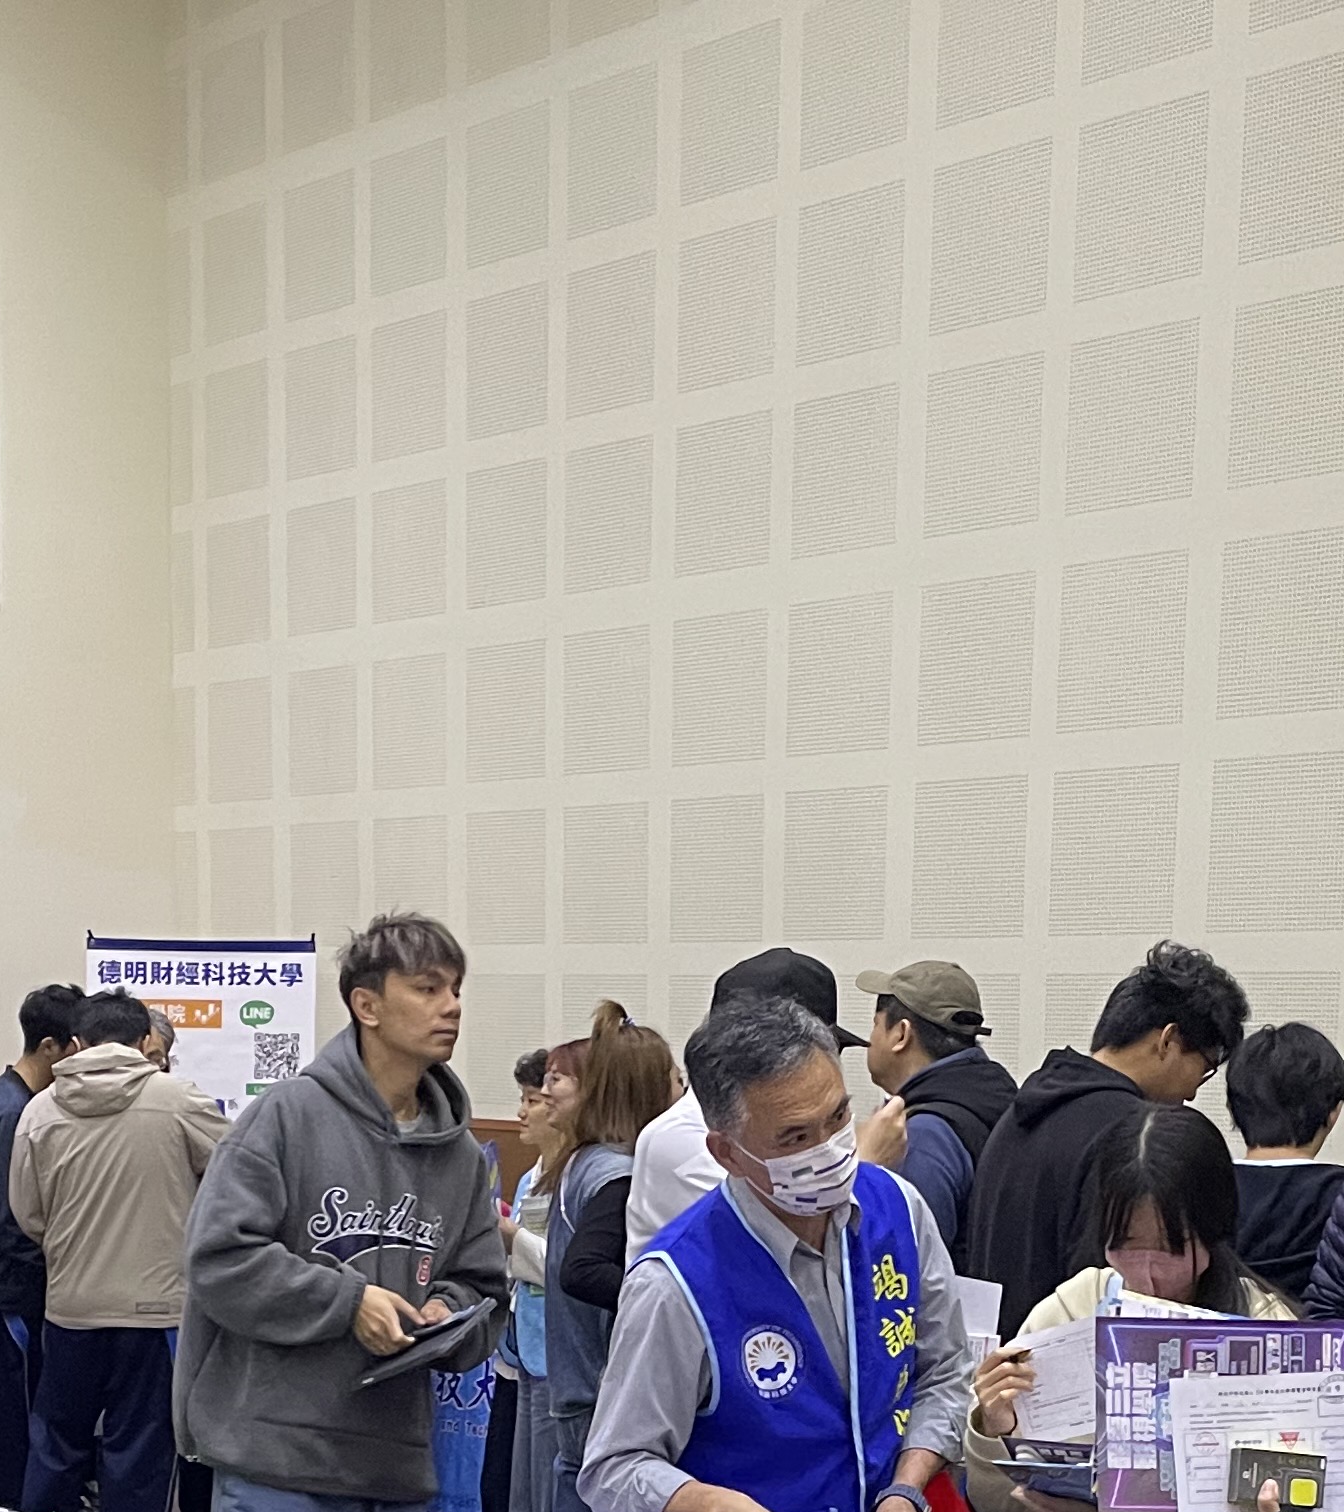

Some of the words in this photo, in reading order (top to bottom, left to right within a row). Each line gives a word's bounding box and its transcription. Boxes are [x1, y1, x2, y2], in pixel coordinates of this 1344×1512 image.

[97, 960, 304, 987] 德明財經科技大學
[242, 1007, 272, 1020] LINE
